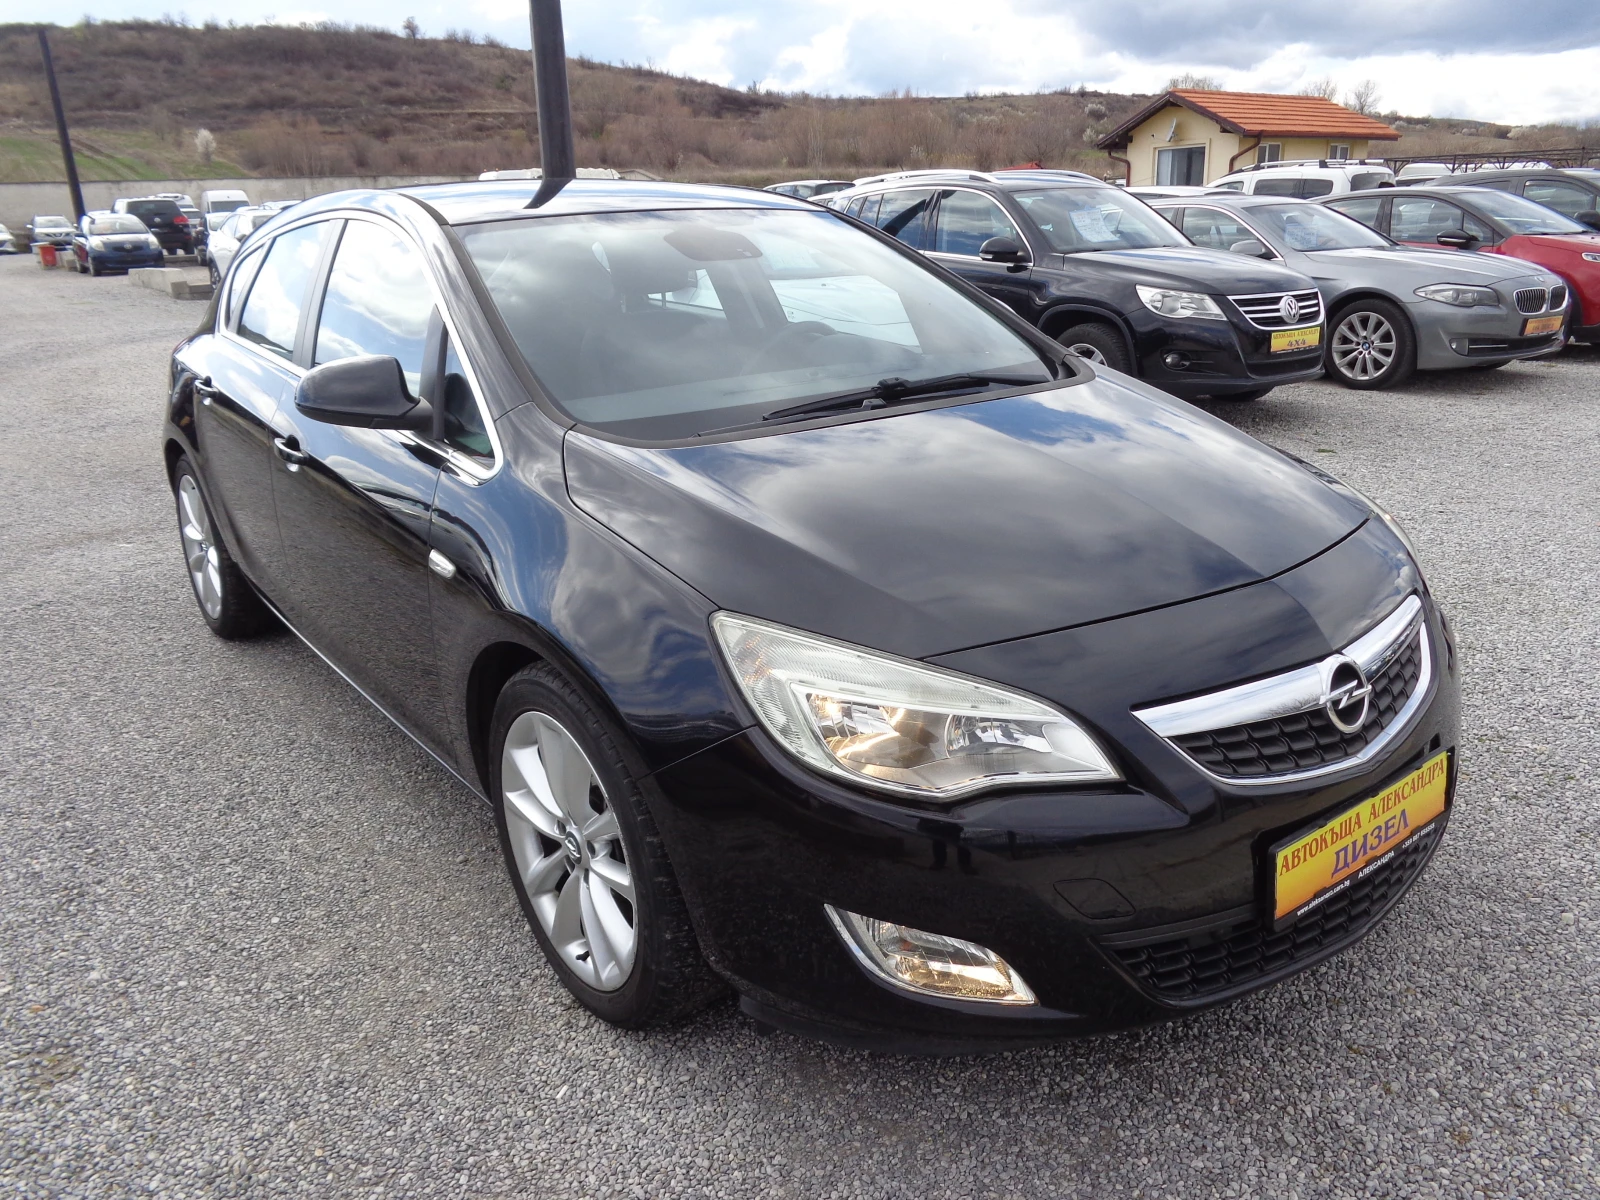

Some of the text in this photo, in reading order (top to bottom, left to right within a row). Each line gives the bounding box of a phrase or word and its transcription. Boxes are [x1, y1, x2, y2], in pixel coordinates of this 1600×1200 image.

[1279, 757, 1445, 876] АВТОКЪЩА АЛЕКСАНДРА
[1331, 808, 1409, 879] ДИЗЕЛ
[1357, 850, 1395, 879] АЛЕКСАНДРА
